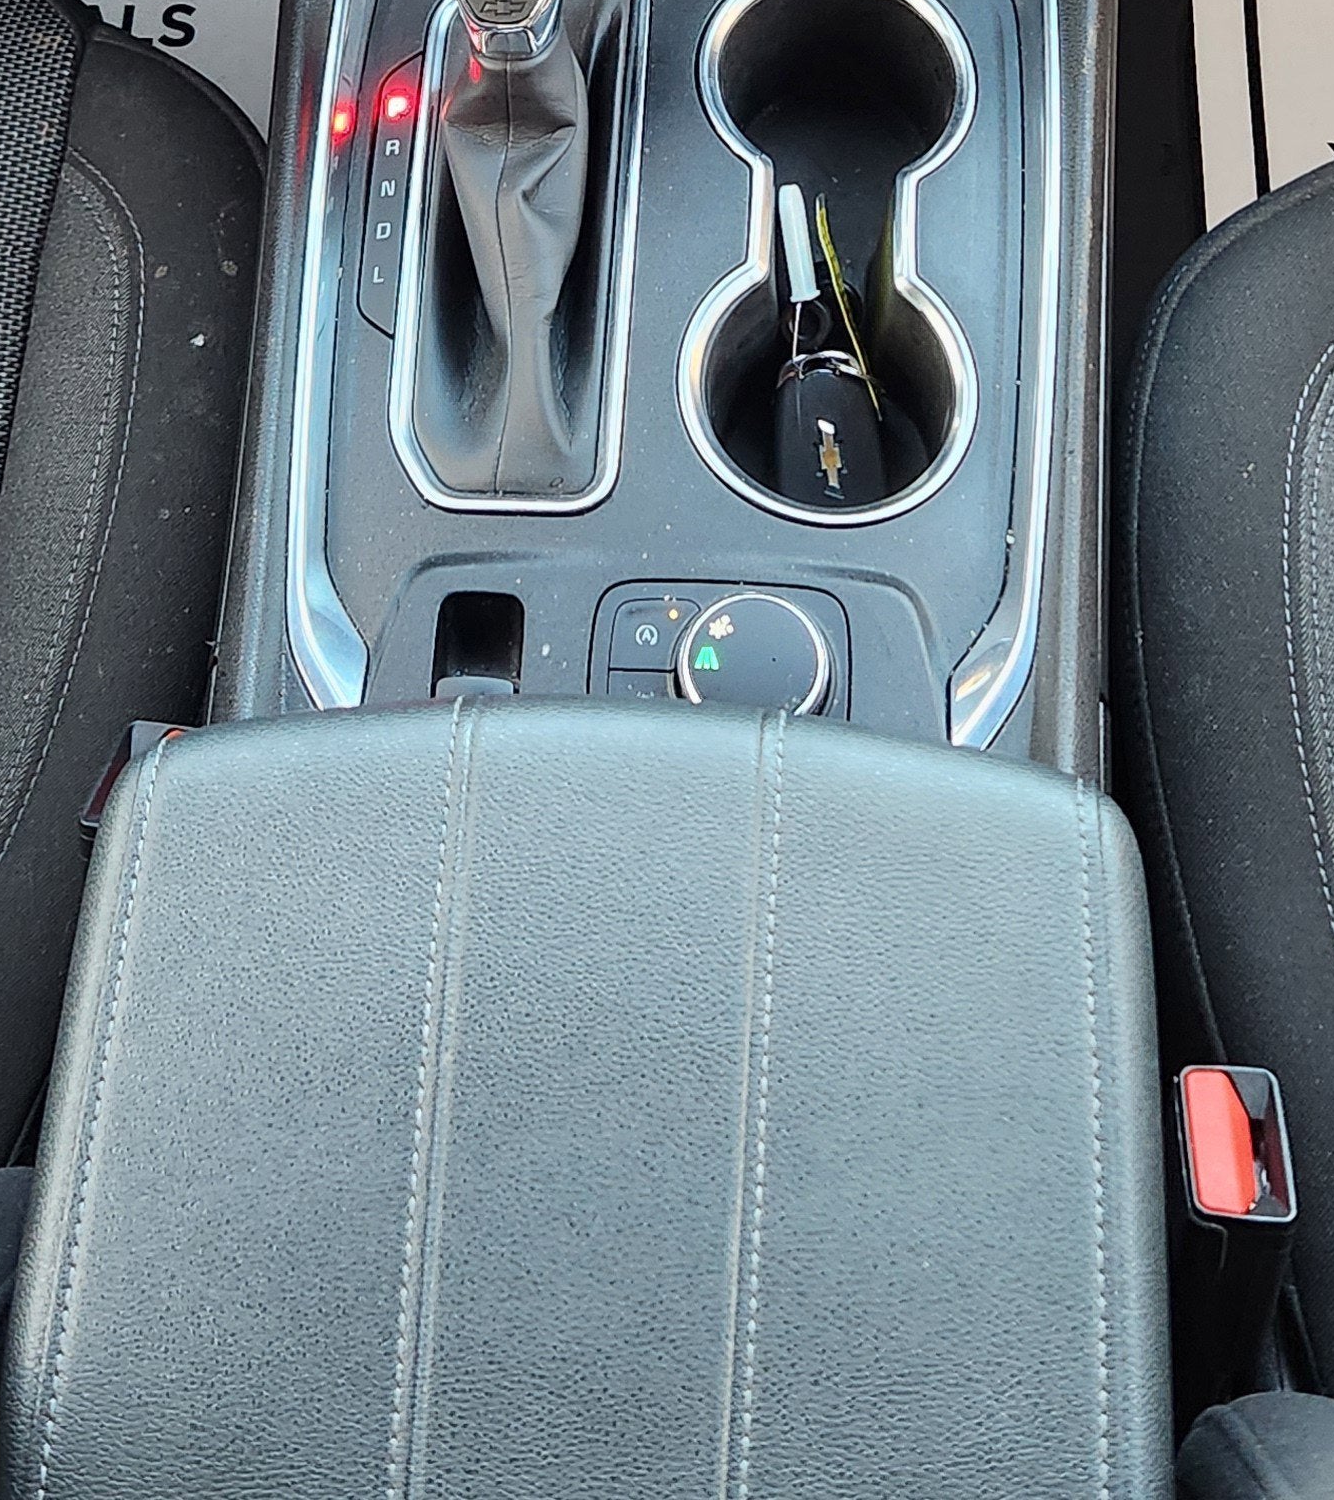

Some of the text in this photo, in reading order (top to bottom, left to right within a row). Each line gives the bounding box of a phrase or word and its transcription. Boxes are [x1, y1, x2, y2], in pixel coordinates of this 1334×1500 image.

[384, 139, 401, 157] R
[380, 179, 397, 198] N
[375, 221, 392, 240] D
[372, 265, 385, 284] L
